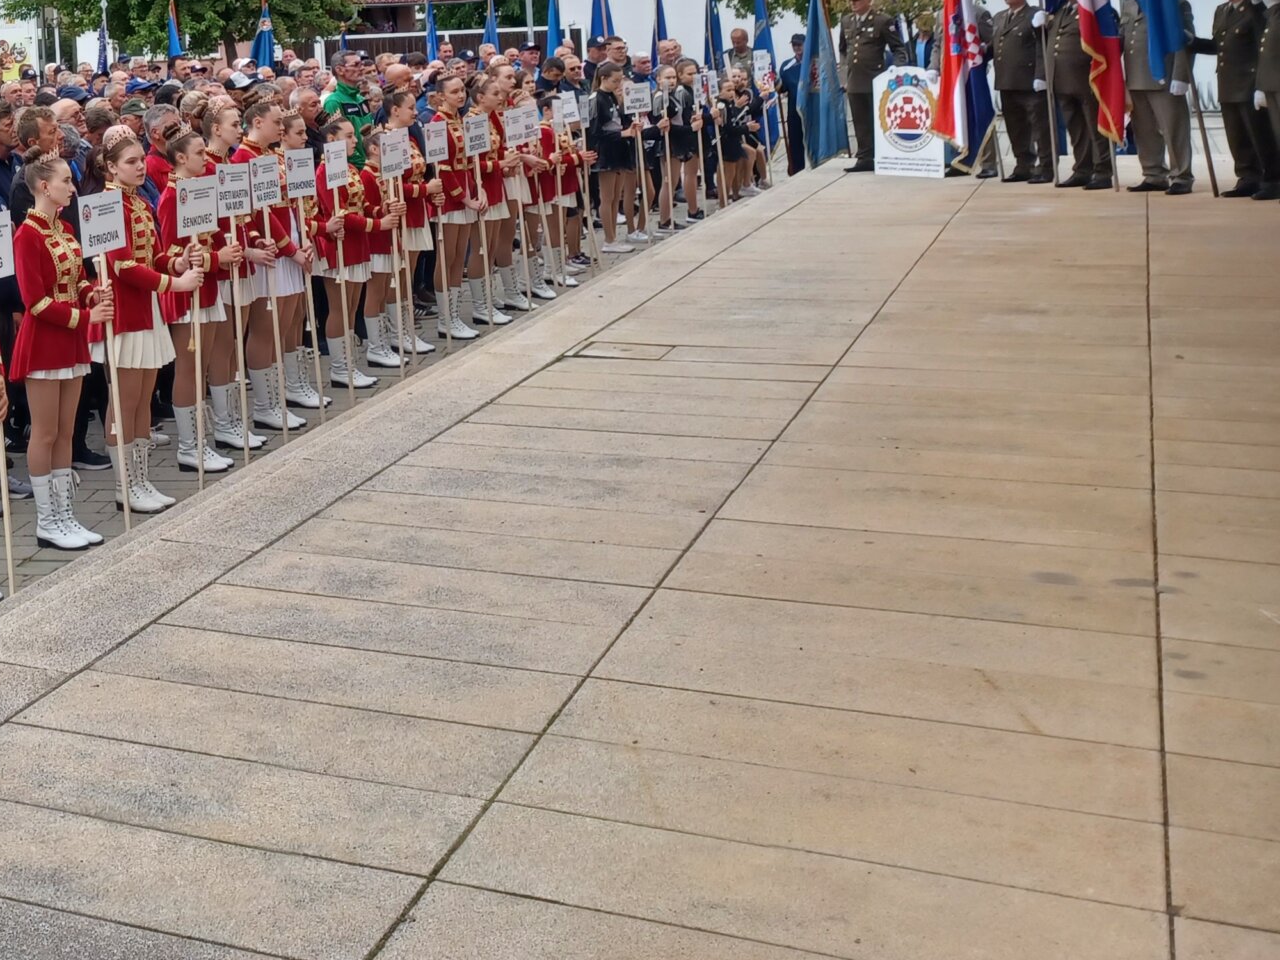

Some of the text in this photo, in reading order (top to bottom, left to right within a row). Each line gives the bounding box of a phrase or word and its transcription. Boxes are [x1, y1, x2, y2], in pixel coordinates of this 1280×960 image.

[253, 179, 278, 192] SVETI JURAJ
[288, 179, 315, 192] STRAHONINEC
[219, 190, 232, 200] SVETI
[232, 189, 248, 199] MARTIN
[257, 191, 278, 202] NA BREGU
[225, 201, 243, 211] NA MURI
[182, 213, 212, 228] ŠENKOVEC
[88, 229, 119, 247] ŠTRIGOVA
